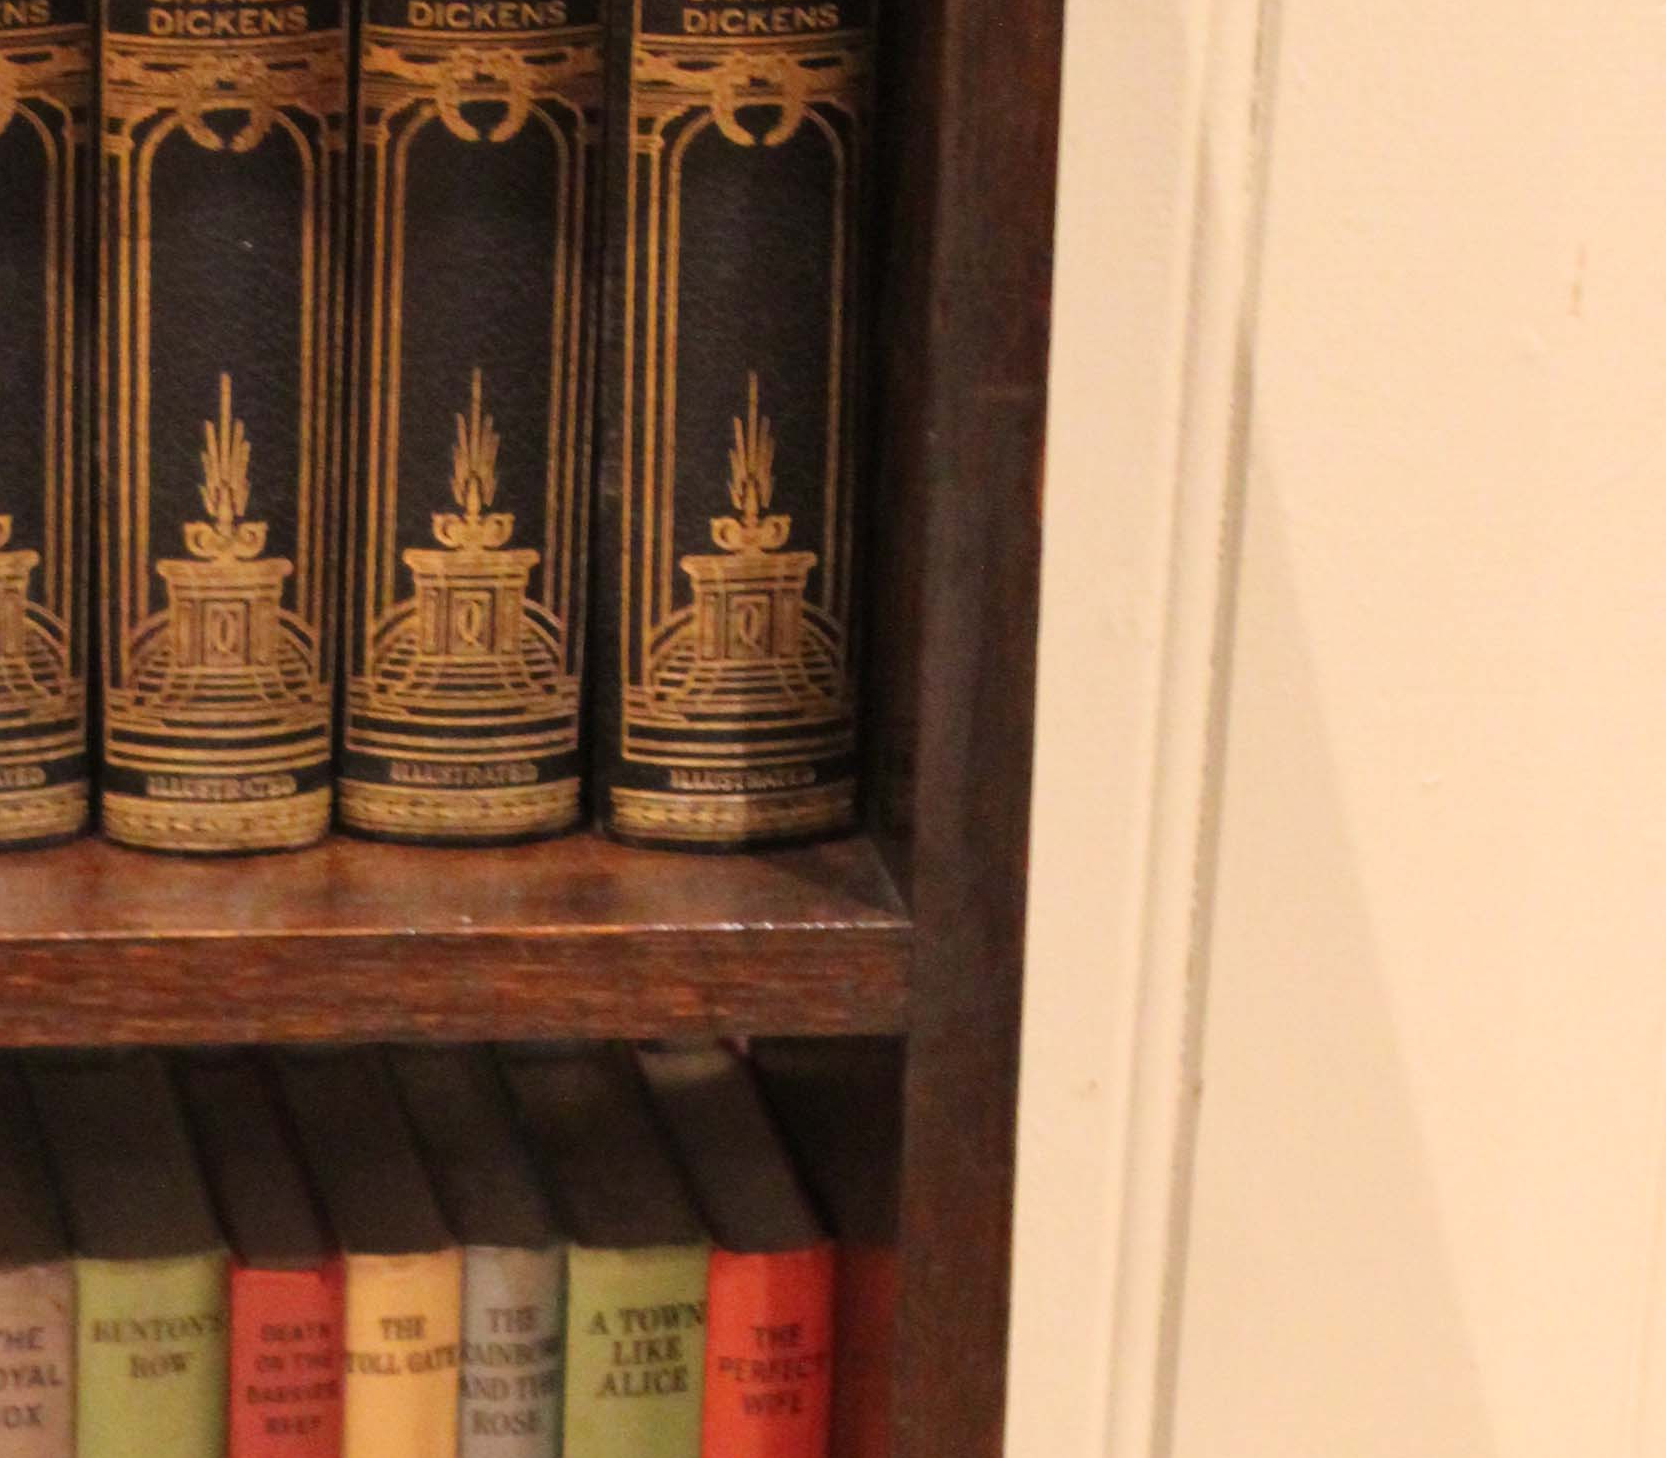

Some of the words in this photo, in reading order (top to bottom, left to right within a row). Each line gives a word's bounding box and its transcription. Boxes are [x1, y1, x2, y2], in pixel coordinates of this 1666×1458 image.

[149, 8, 305, 36] DICKENS
[409, 2, 566, 29] DICKENS
[683, 4, 838, 34] DICKENS
[380, 1315, 427, 1340] THE
[589, 1311, 608, 1336] A
[617, 1299, 706, 1334] TOWN
[611, 1335, 682, 1367] LIKE
[596, 1366, 688, 1400] ALICE
[472, 1411, 538, 1436] ROSE
